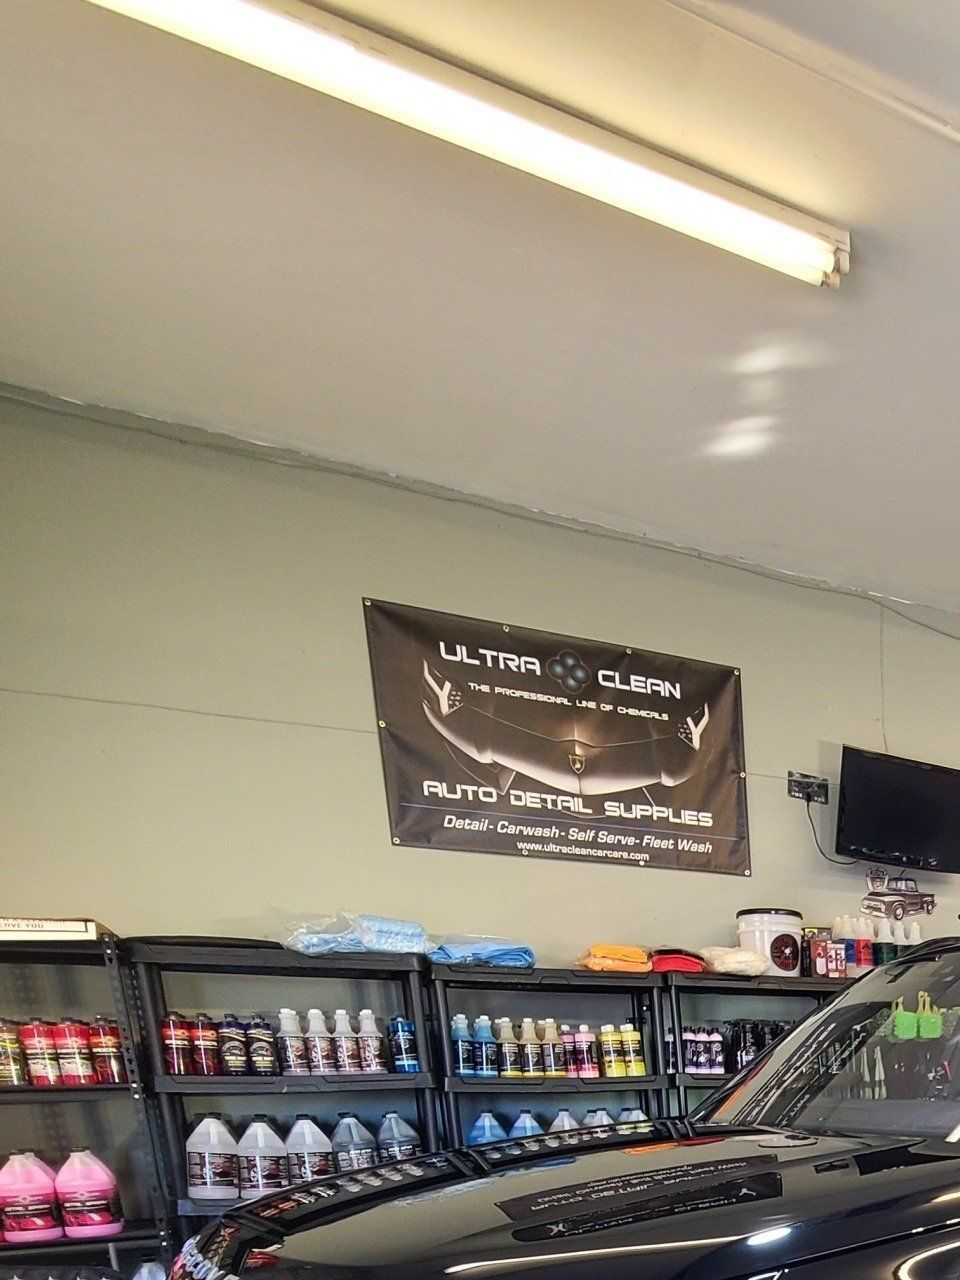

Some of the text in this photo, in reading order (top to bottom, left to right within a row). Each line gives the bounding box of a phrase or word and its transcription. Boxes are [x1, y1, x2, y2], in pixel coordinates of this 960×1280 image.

[439, 641, 682, 699] ULTRA CLEAN
[467, 682, 669, 721] THE PROFESSIONAL LINE OF CHEMICALS
[422, 780, 714, 827] AUTO DETAIL SUPPLIES
[516, 841, 650, 861] www.ultracleancarcare.com
[568, 828, 595, 842] Self
[642, 835, 675, 850] Fleet
[677, 839, 713, 853] Wash
